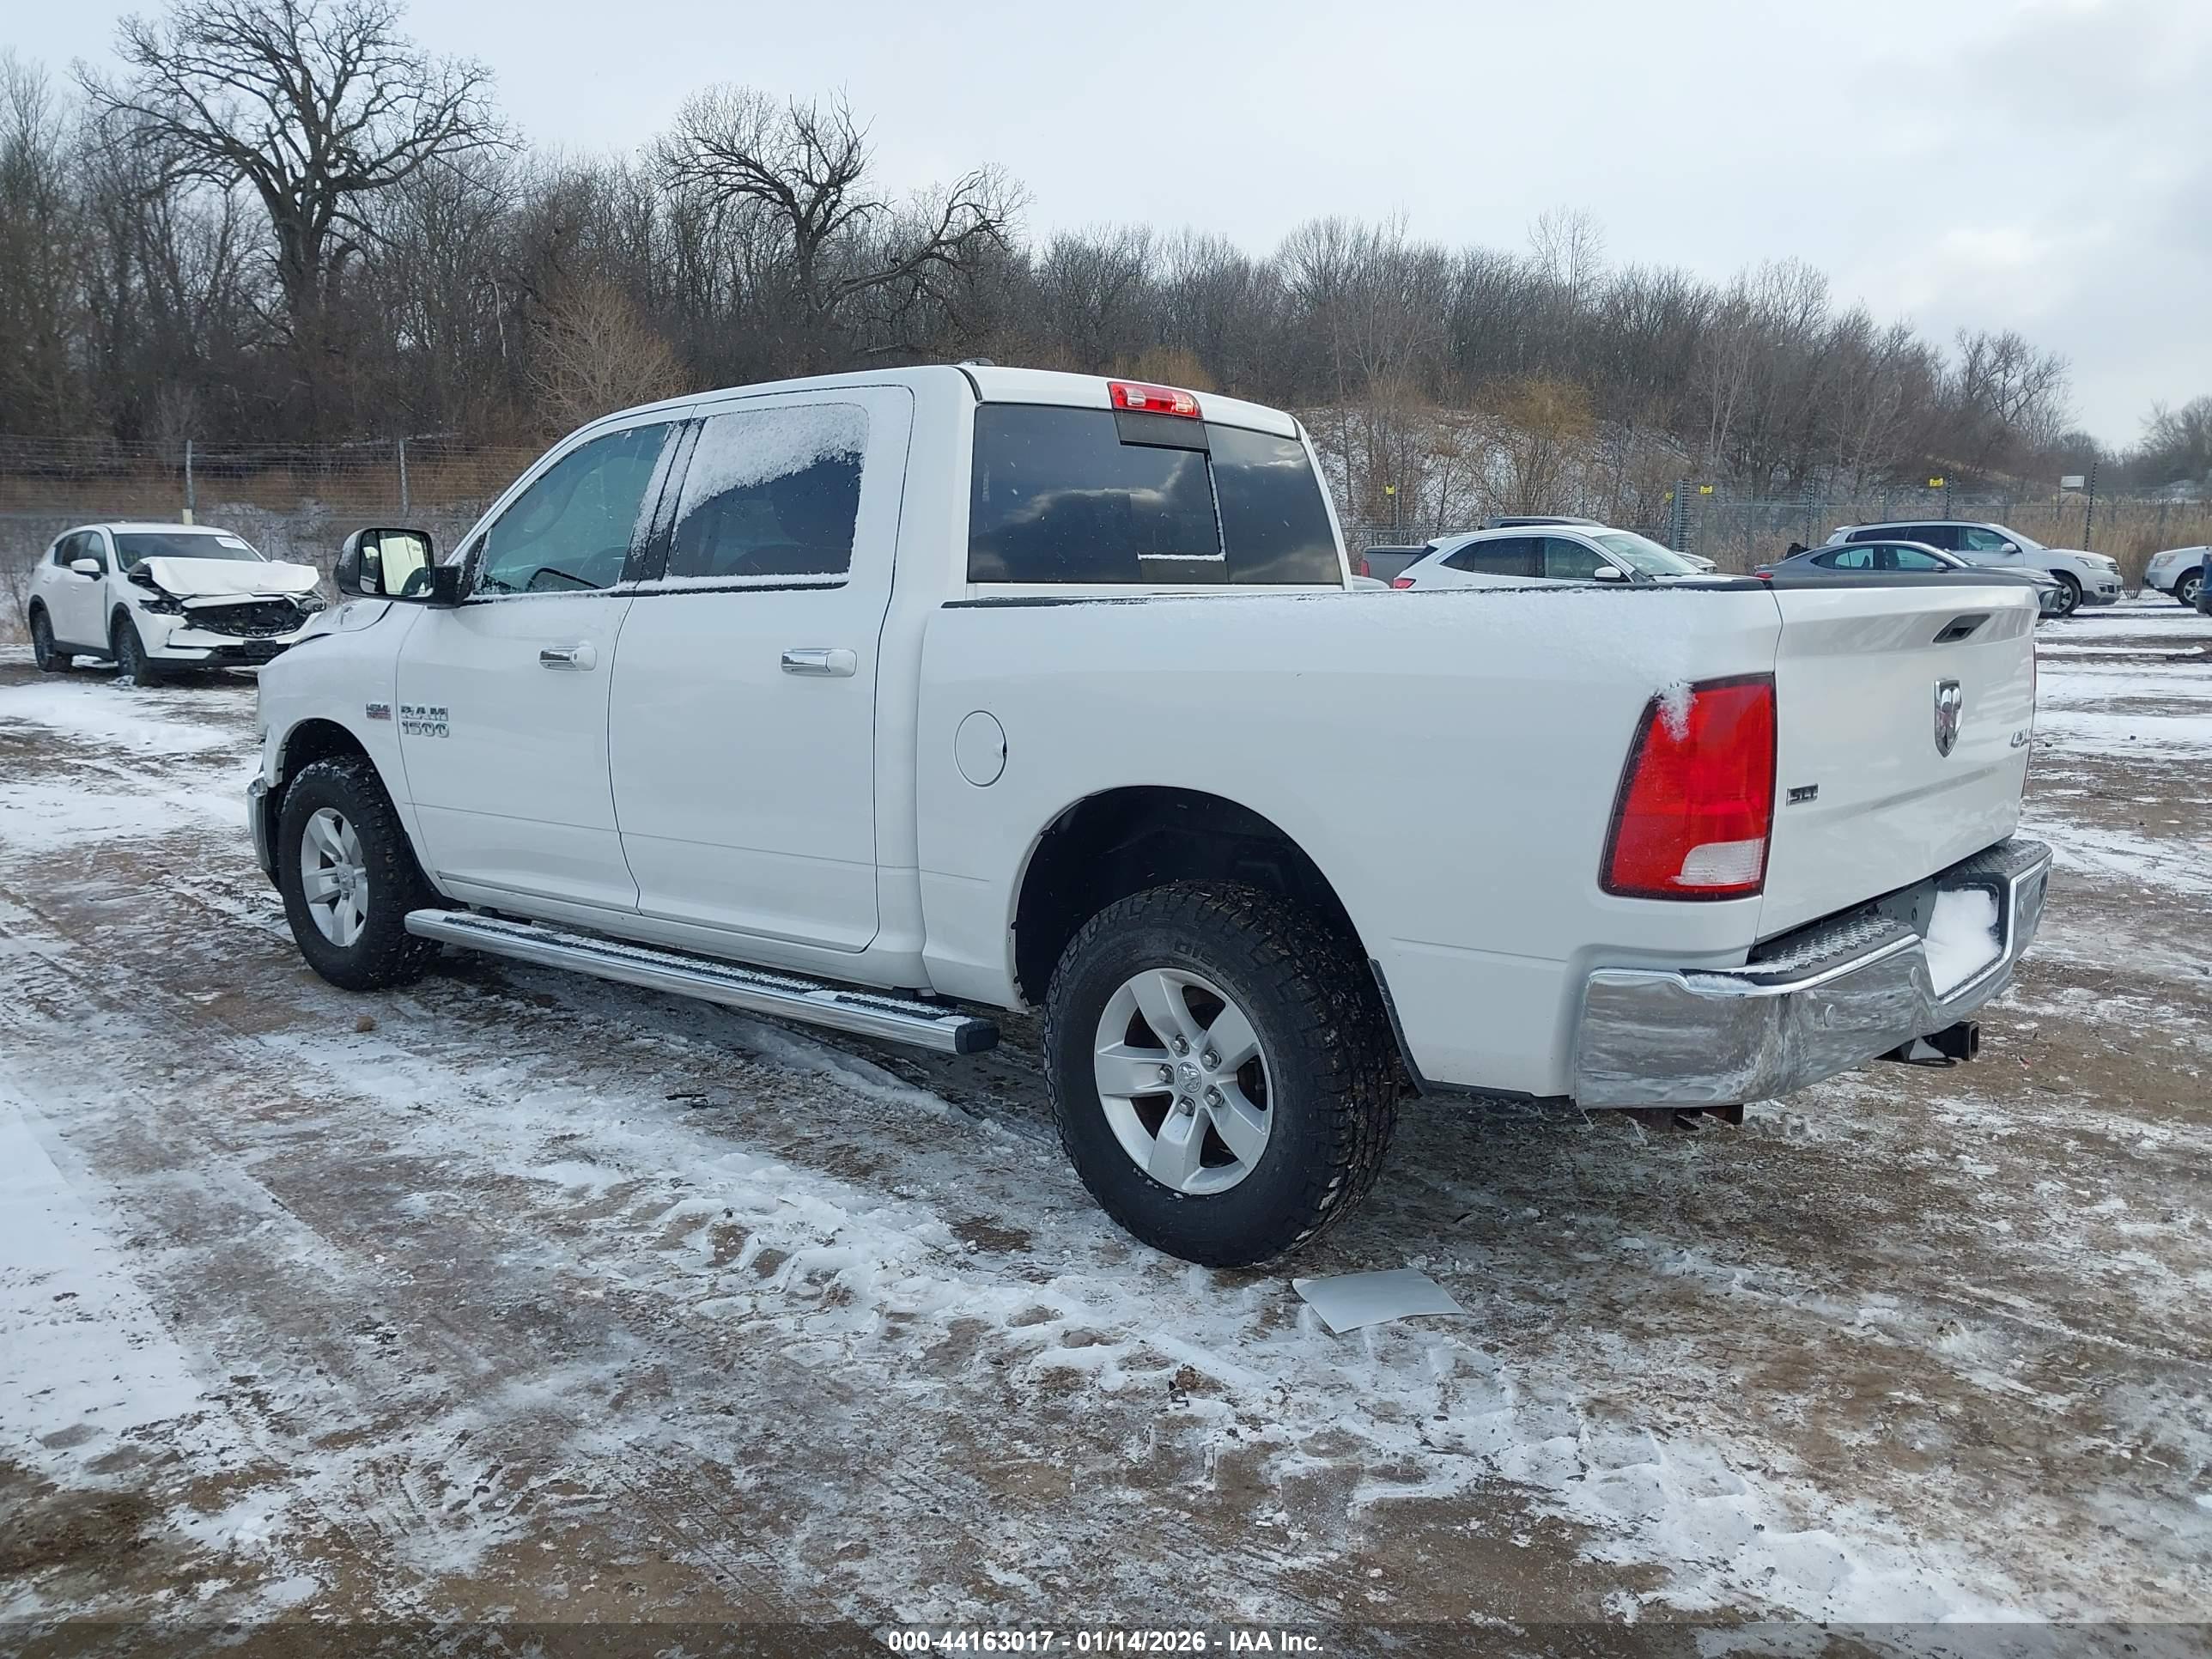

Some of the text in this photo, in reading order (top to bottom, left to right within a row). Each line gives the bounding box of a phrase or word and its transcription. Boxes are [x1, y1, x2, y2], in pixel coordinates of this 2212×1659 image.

[400, 705, 448, 721] RAM
[401, 720, 449, 738] 1500
[1790, 785, 1818, 804] SLT
